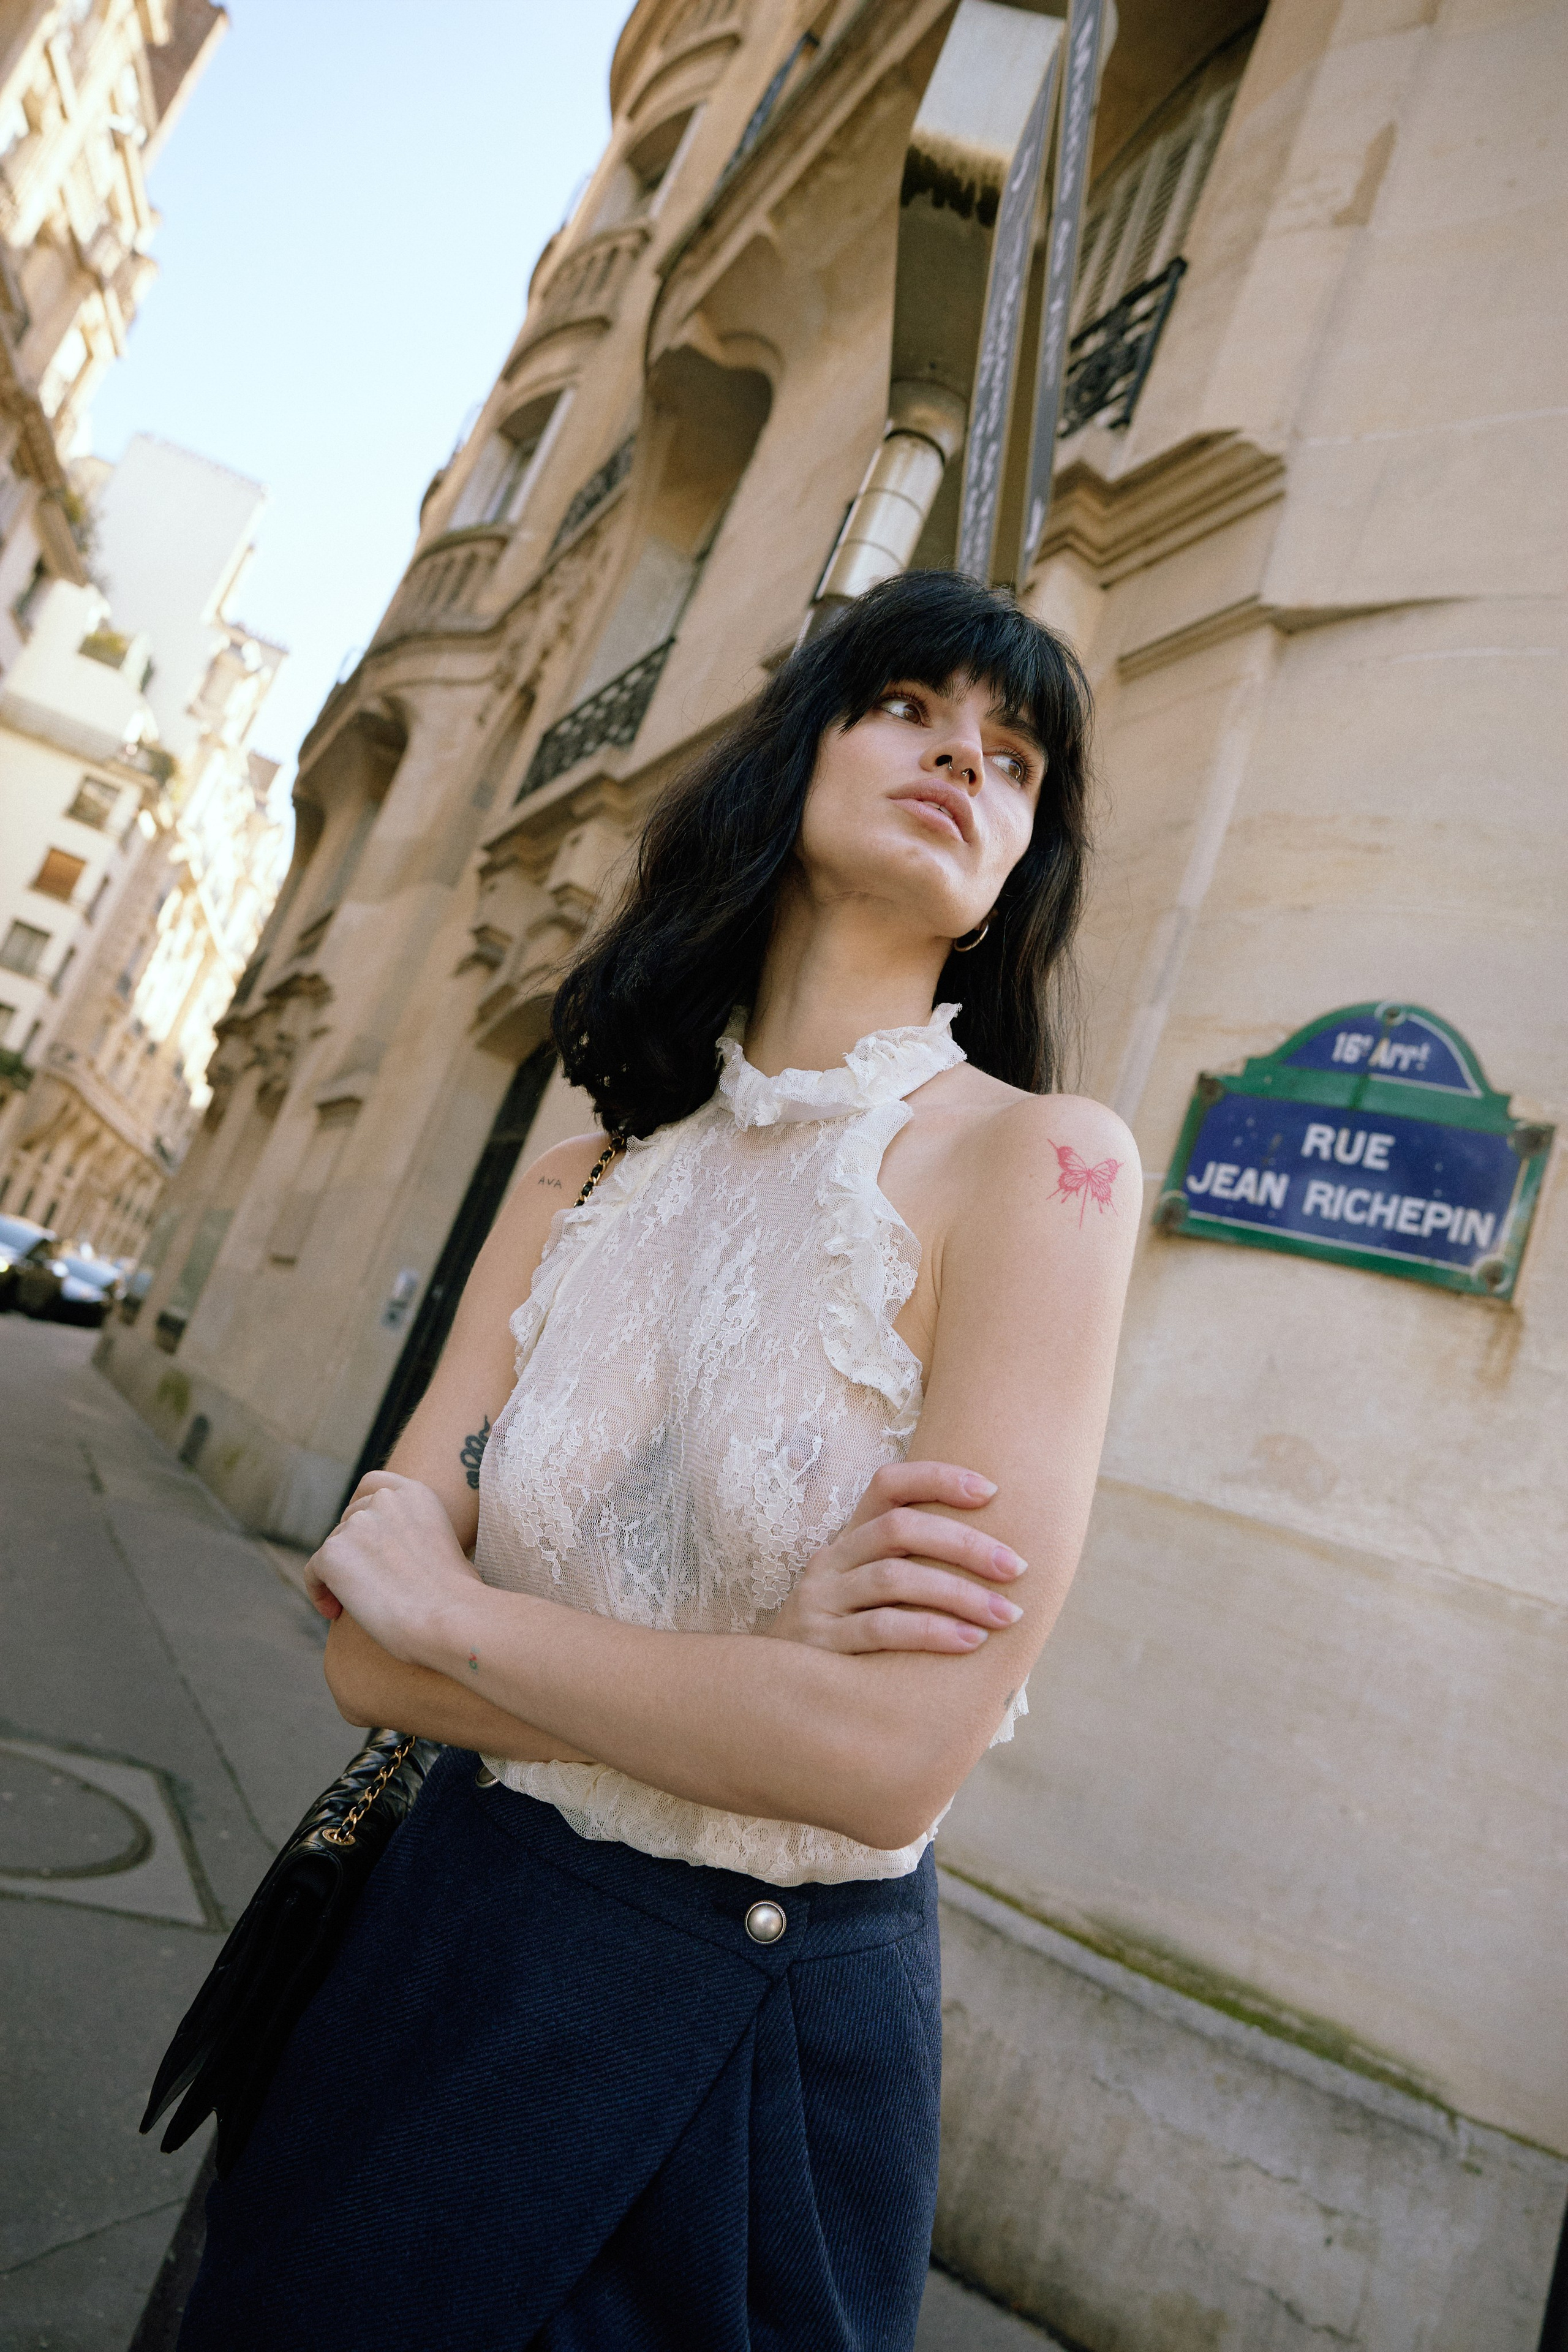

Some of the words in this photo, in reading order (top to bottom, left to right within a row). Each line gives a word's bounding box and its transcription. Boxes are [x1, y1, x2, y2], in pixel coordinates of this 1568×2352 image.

[1302, 1124, 1395, 1170] RUE
[538, 1176, 562, 1189] AVA
[1187, 1162, 1289, 1208] JEAN
[1303, 1180, 1494, 1246] RICHEPIN
